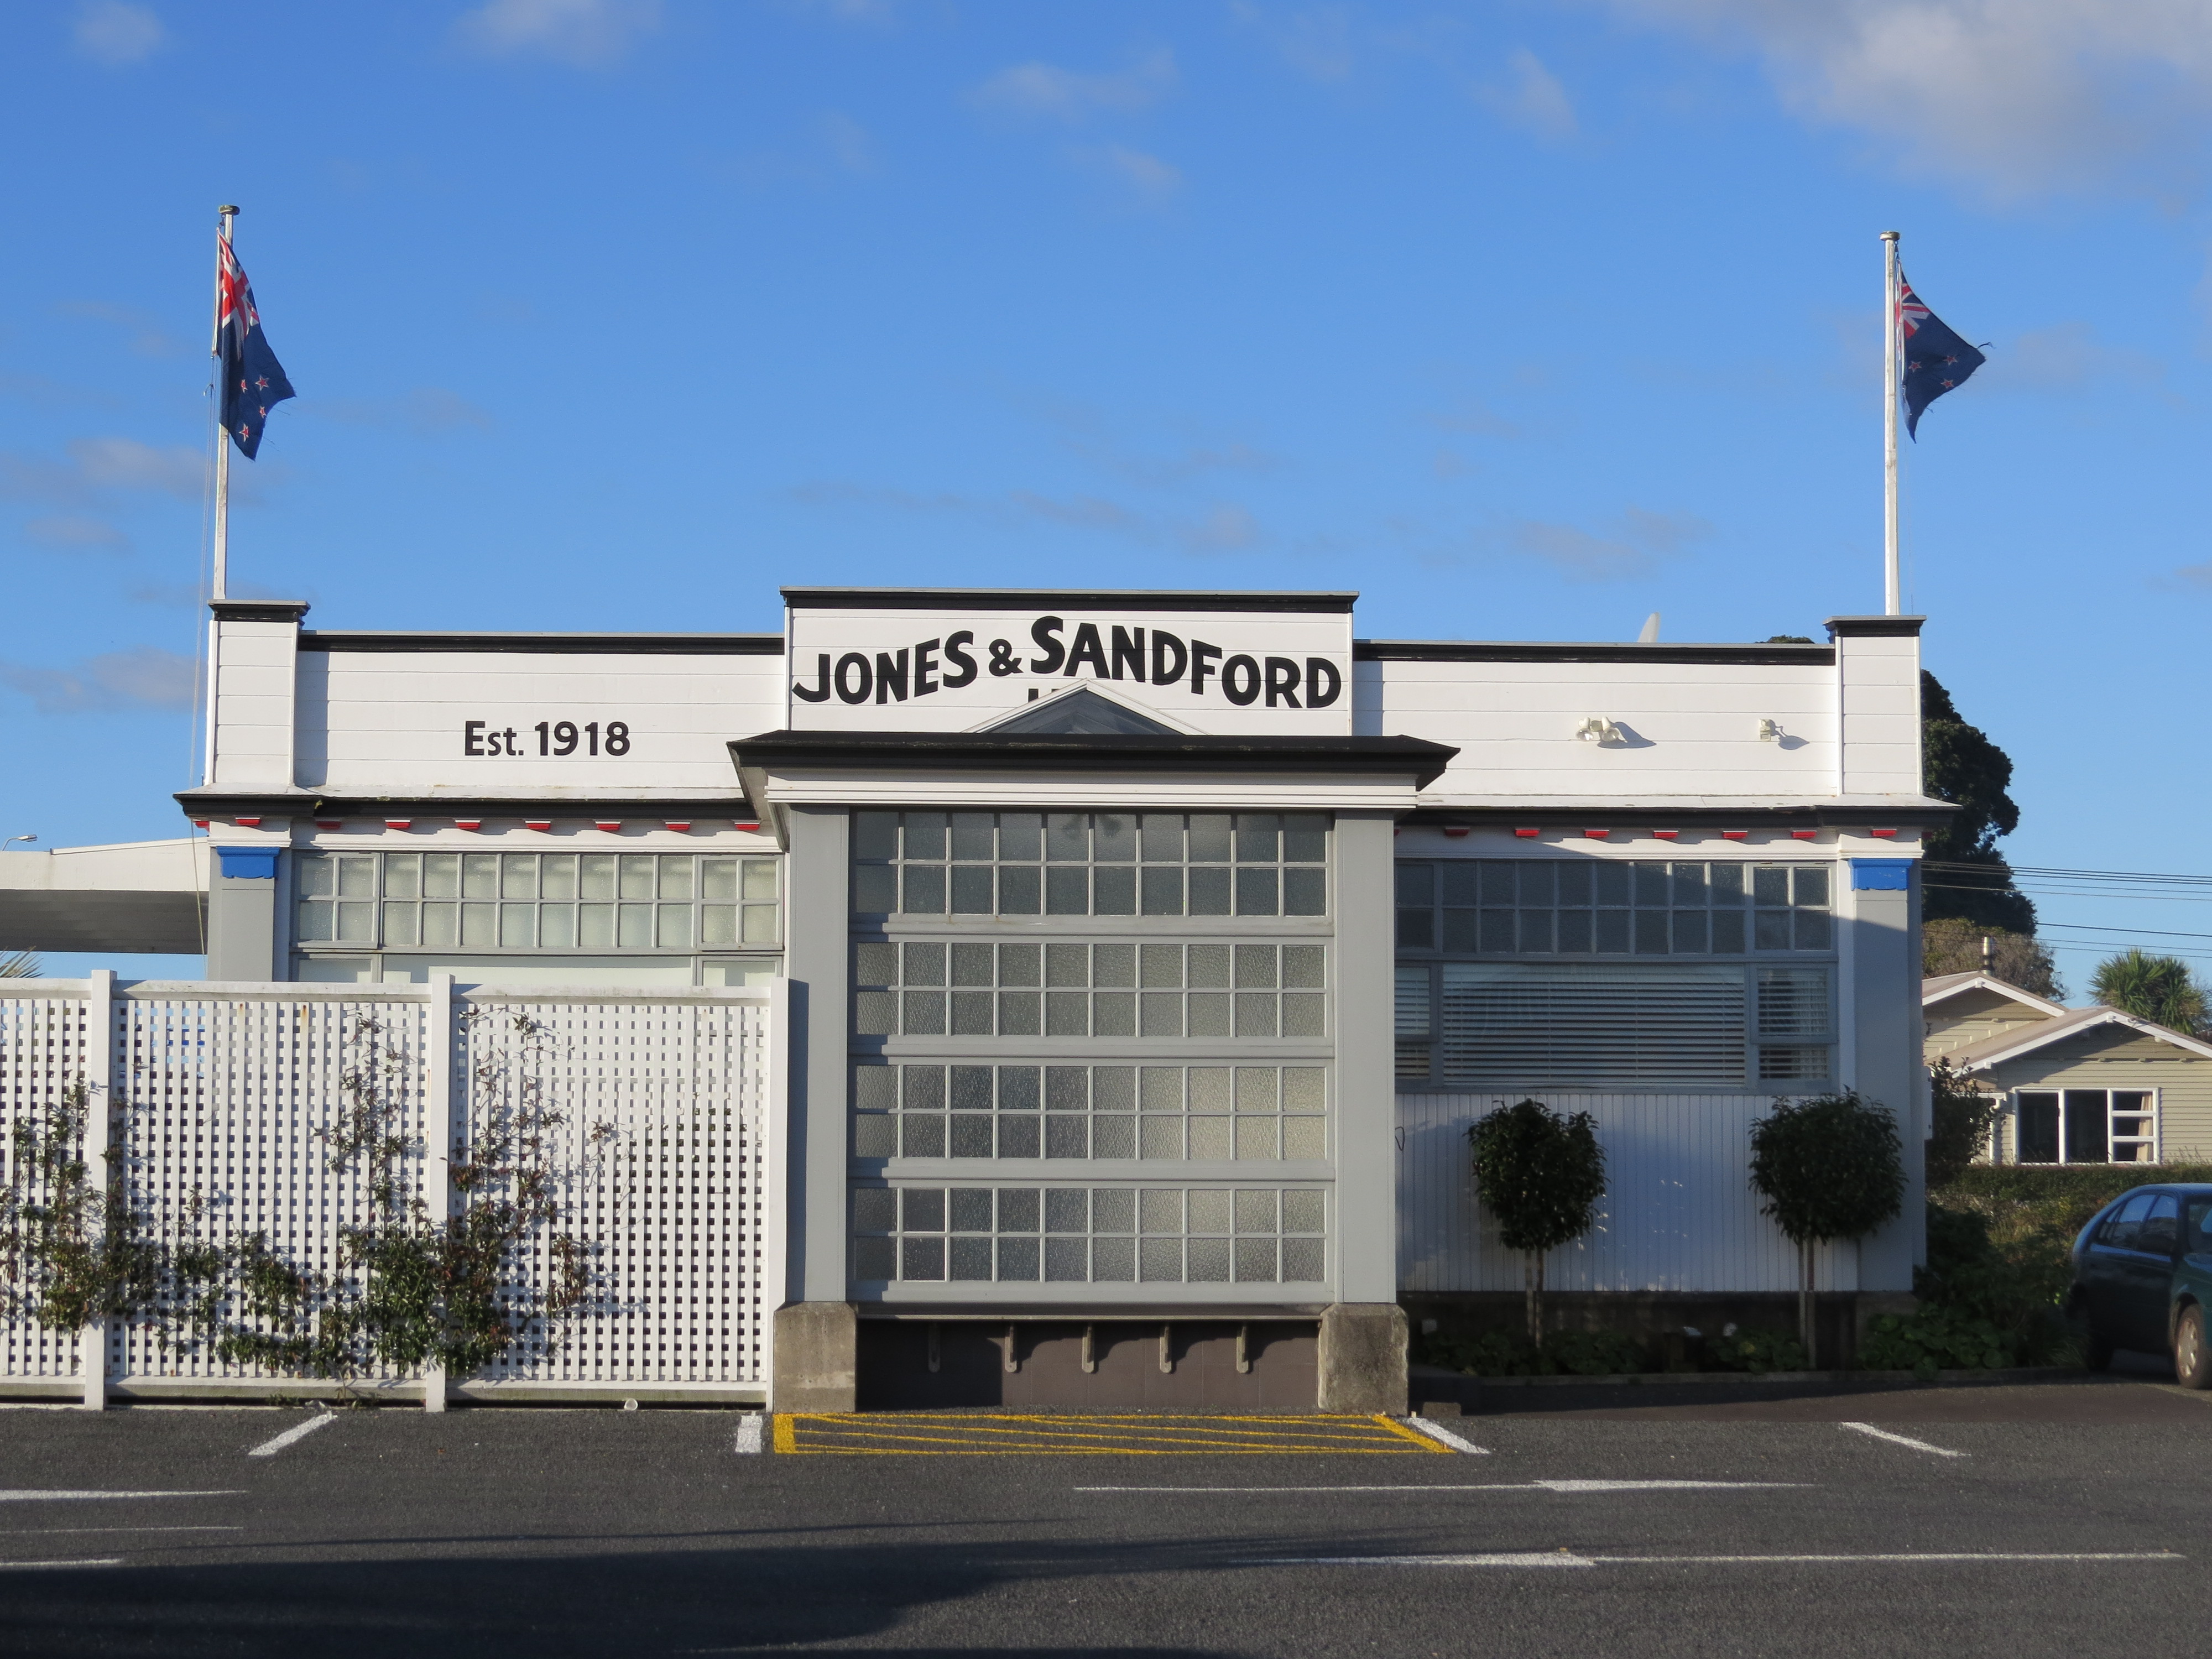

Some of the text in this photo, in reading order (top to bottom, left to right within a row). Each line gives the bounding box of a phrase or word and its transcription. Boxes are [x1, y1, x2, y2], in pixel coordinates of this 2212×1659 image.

[791, 615, 1342, 708] JONES & SANDFORD
[465, 721, 630, 756] Est. 1918
